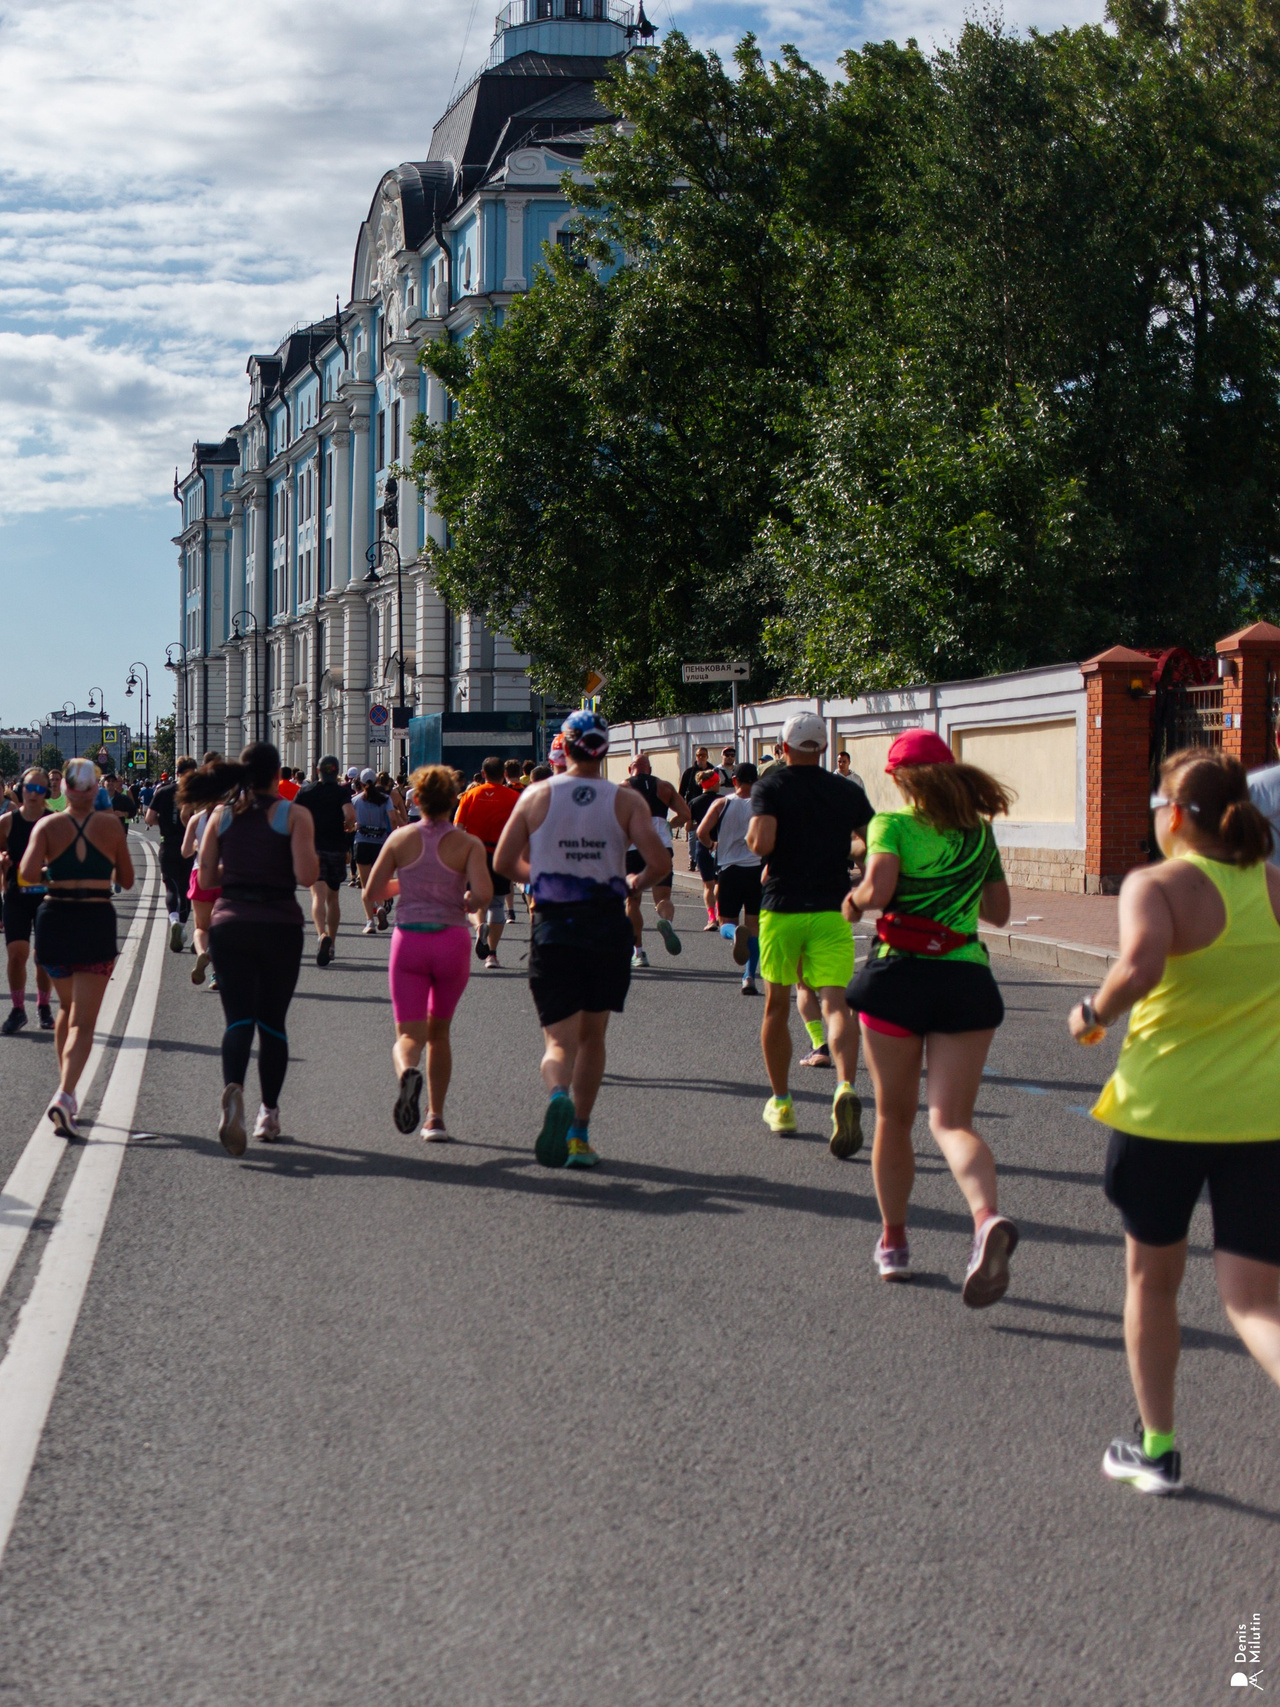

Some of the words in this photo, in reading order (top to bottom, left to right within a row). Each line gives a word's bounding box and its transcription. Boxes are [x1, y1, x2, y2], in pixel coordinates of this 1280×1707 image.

[685, 664, 732, 673] ПЕНЬКОВАЯ
[558, 840, 579, 848] run
[581, 837, 607, 848] beer
[565, 851, 602, 862] repeat
